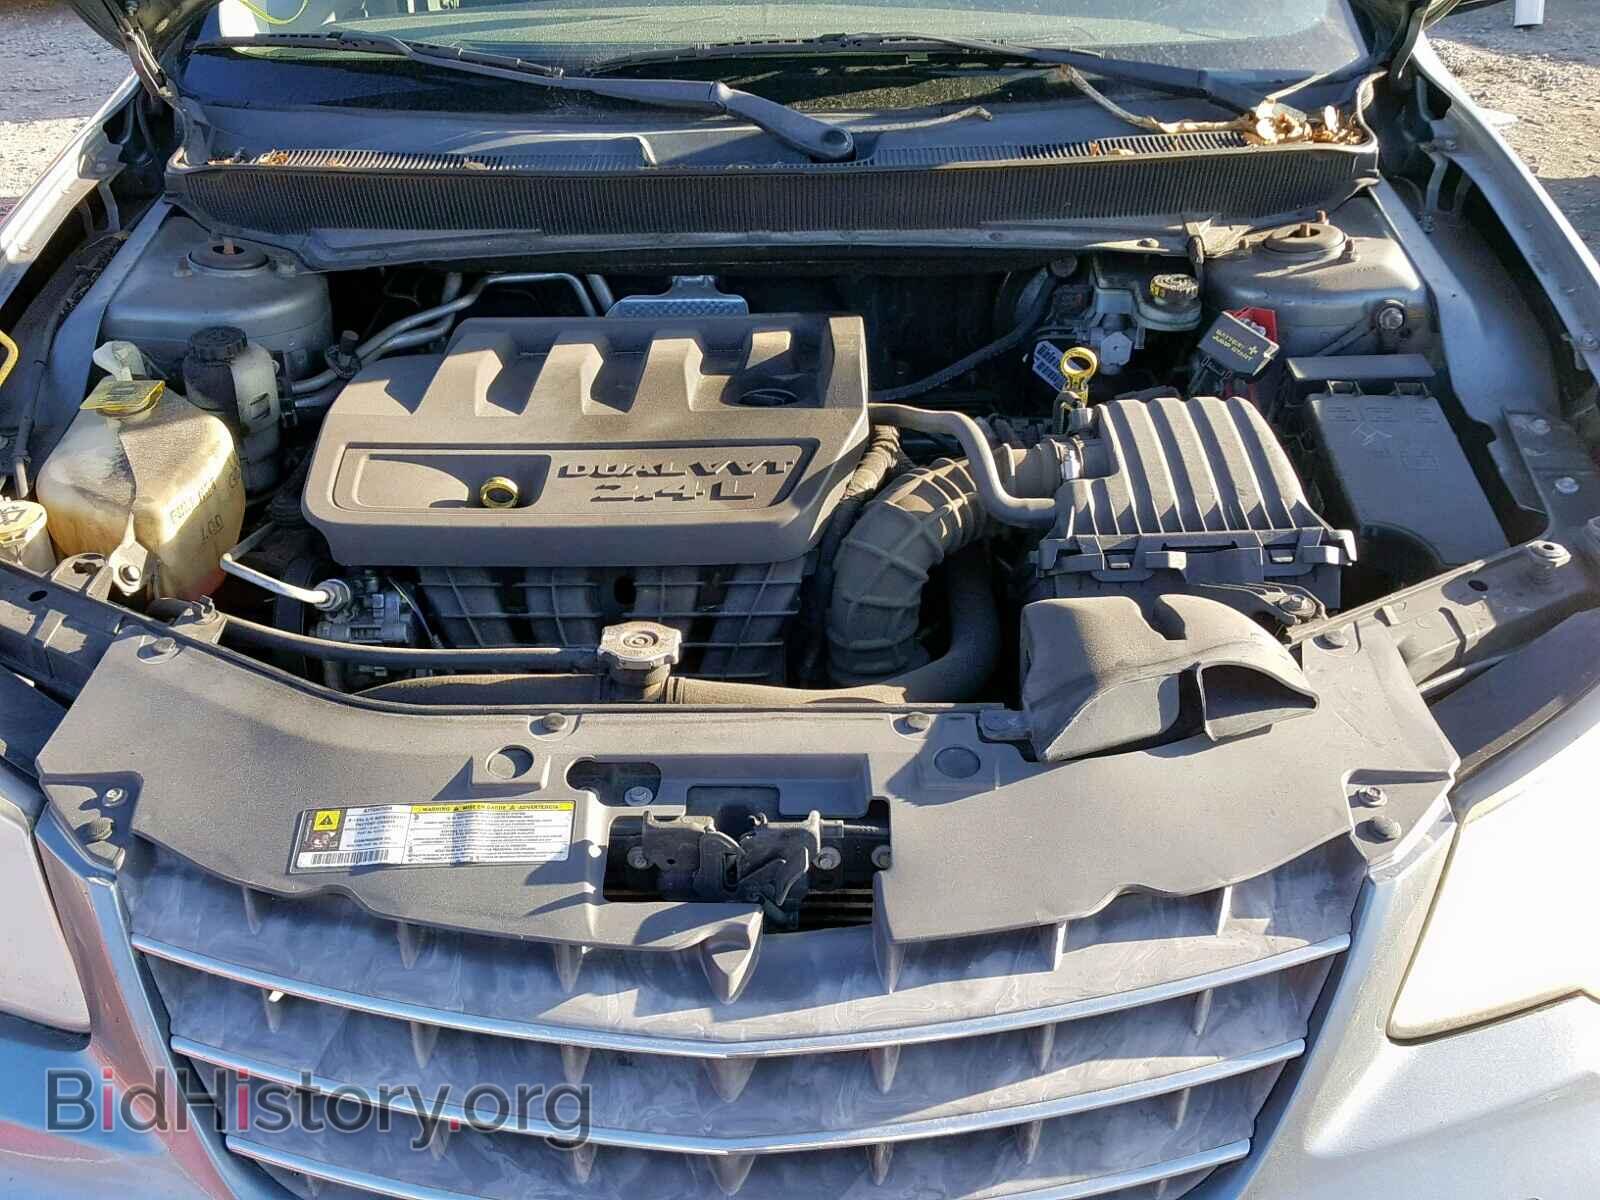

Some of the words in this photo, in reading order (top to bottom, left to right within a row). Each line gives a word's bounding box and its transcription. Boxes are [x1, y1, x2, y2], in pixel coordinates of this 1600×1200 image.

[557, 461, 687, 478] DUAL
[688, 458, 796, 477] VVT
[590, 480, 757, 502] 2.4L
